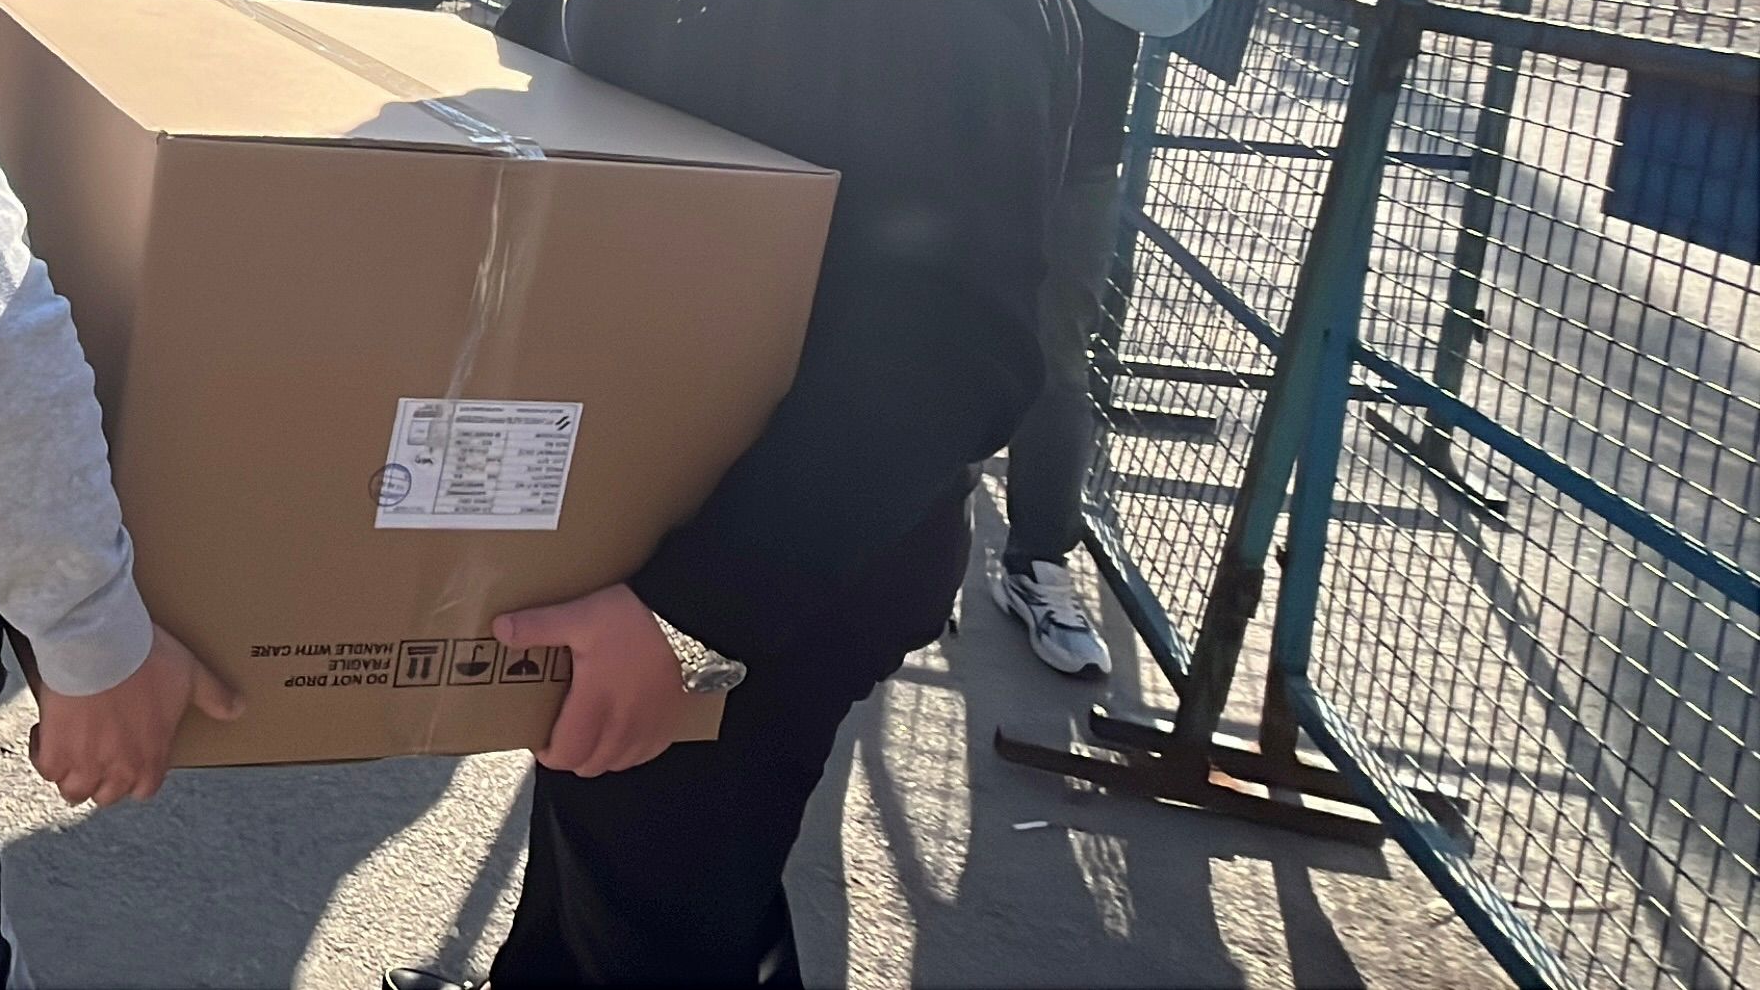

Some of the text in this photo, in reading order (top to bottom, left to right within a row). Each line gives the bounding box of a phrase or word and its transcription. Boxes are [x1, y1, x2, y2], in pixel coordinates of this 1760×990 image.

[250, 643, 393, 658] HANDLE WITH CARE
[328, 658, 391, 671] FRAGILE
[284, 673, 388, 687] DO NOT DROP
